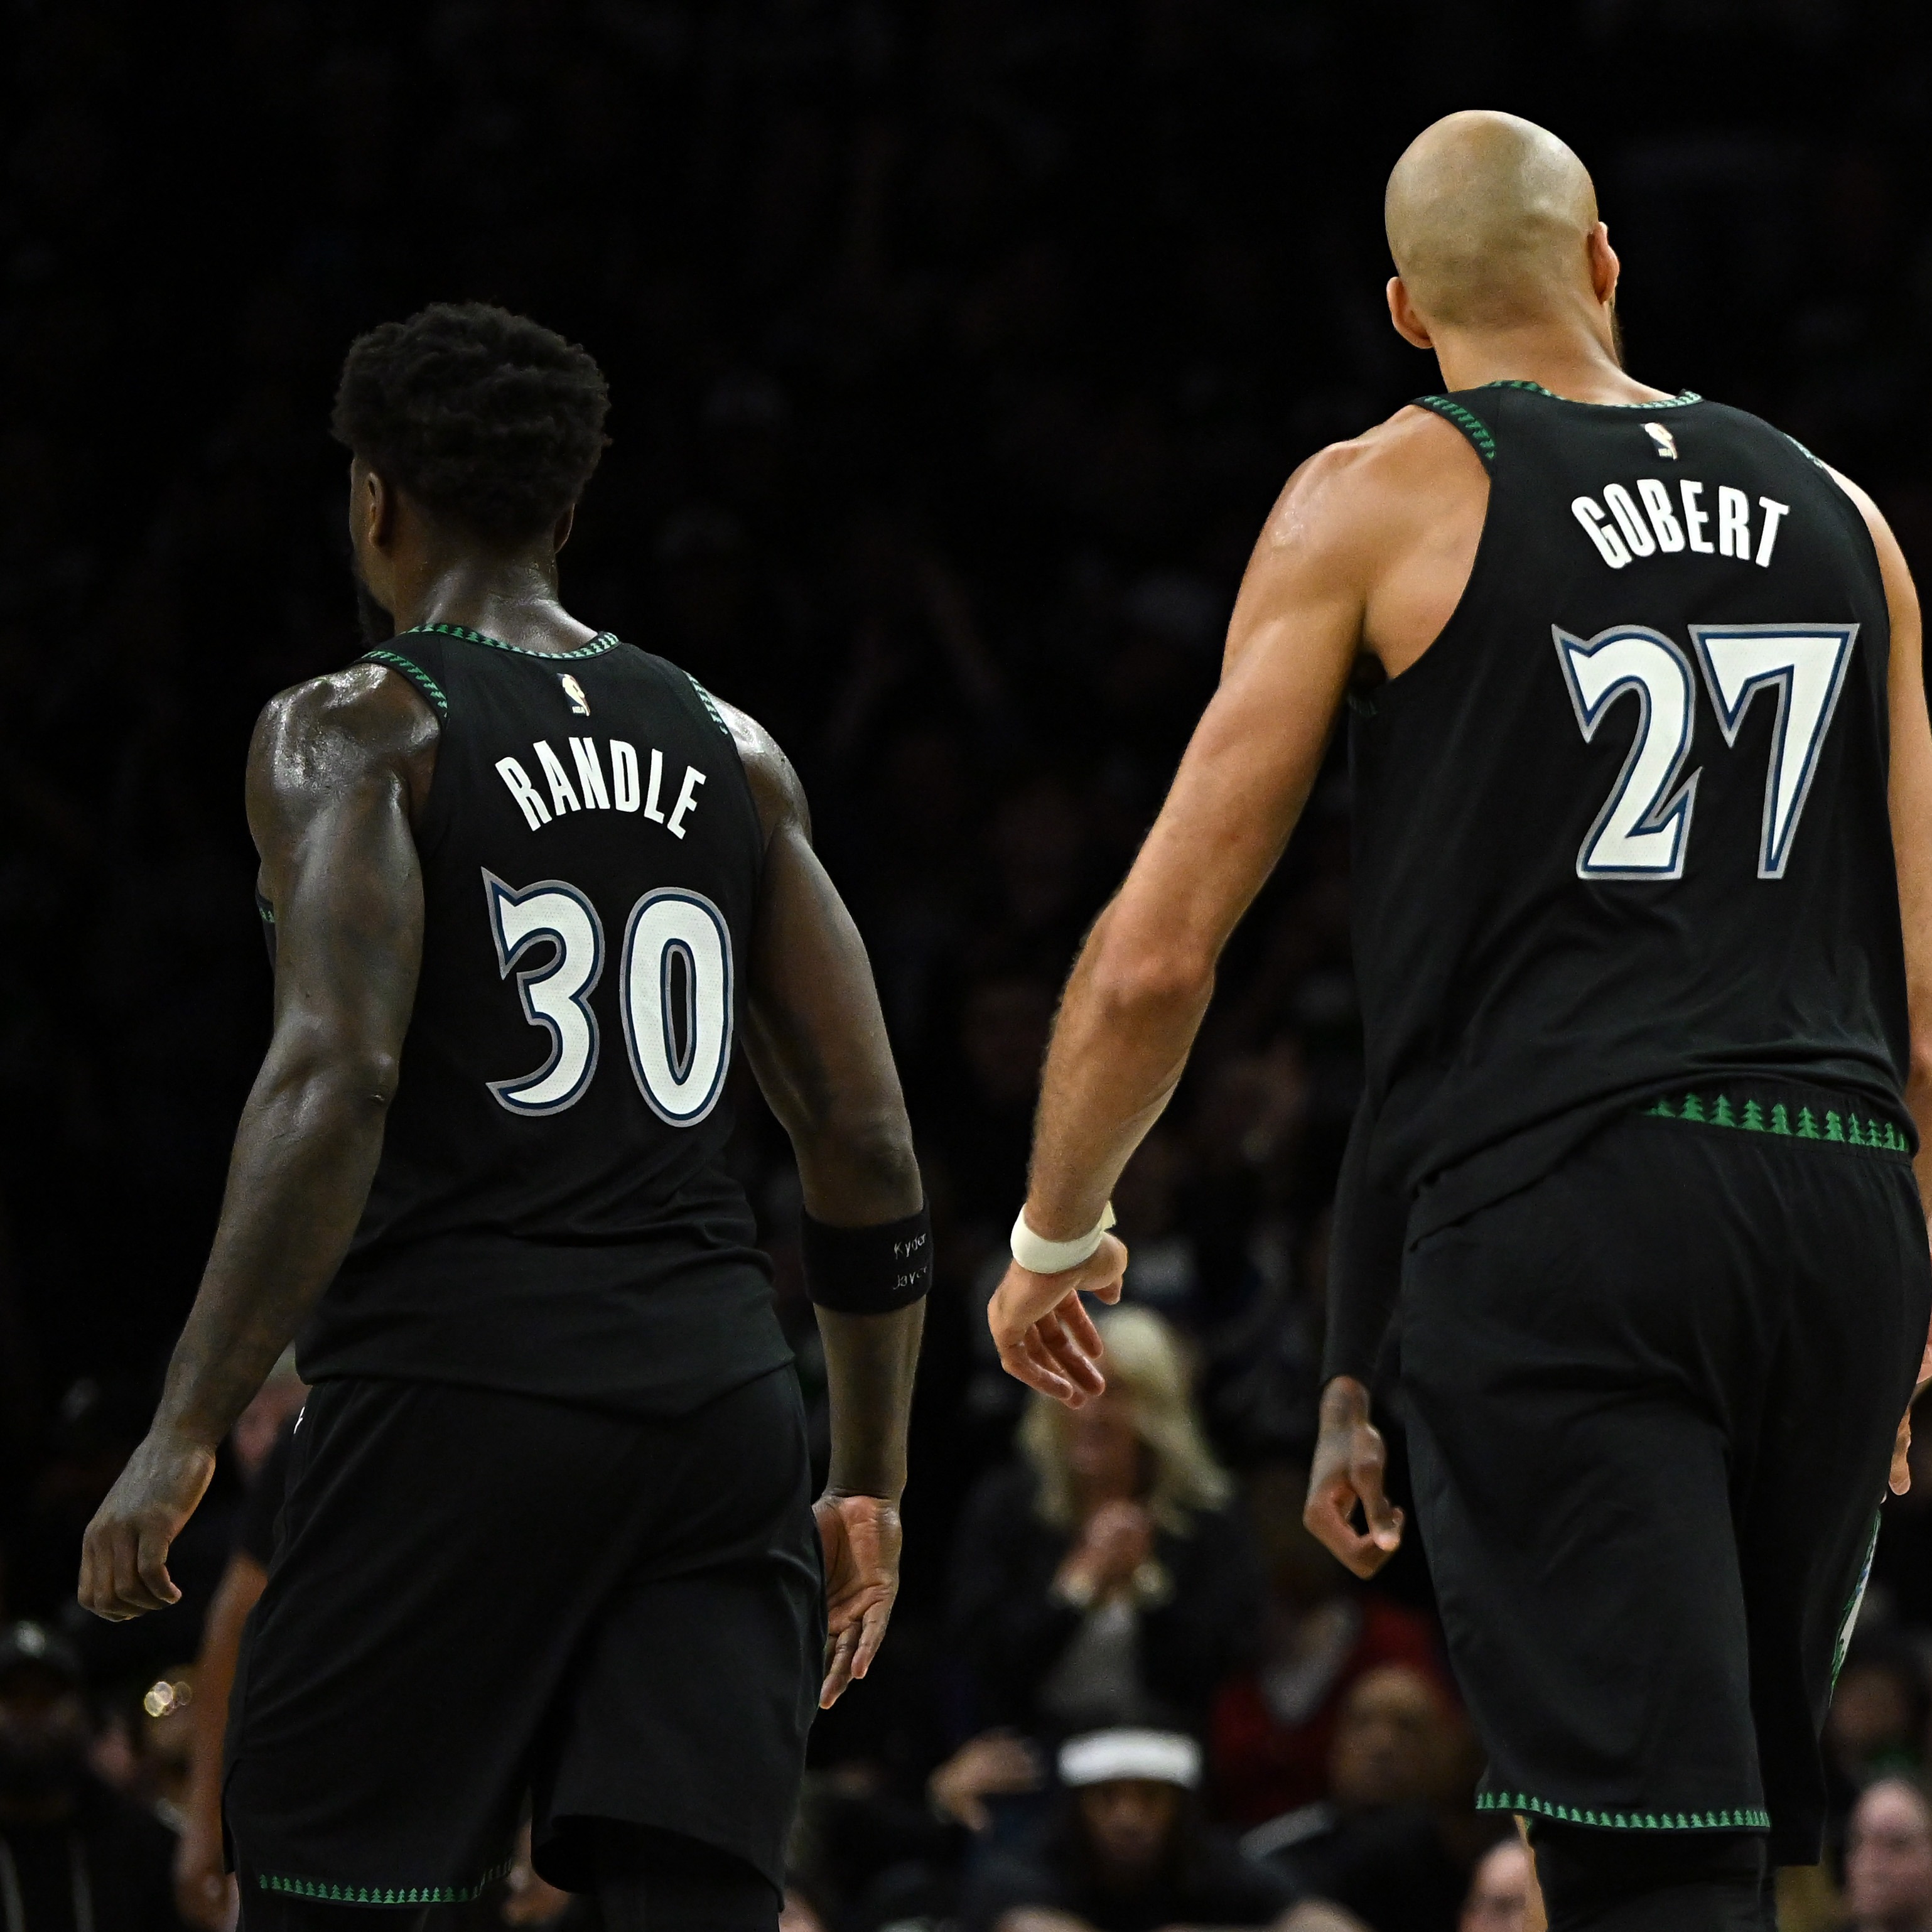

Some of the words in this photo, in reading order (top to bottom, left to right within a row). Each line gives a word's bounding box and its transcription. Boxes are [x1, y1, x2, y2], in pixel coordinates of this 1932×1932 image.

[1571, 478, 1790, 569] GOBERT
[495, 737, 707, 840] RANDLE
[1551, 622, 1861, 882] 27
[480, 866, 735, 1128] 30
